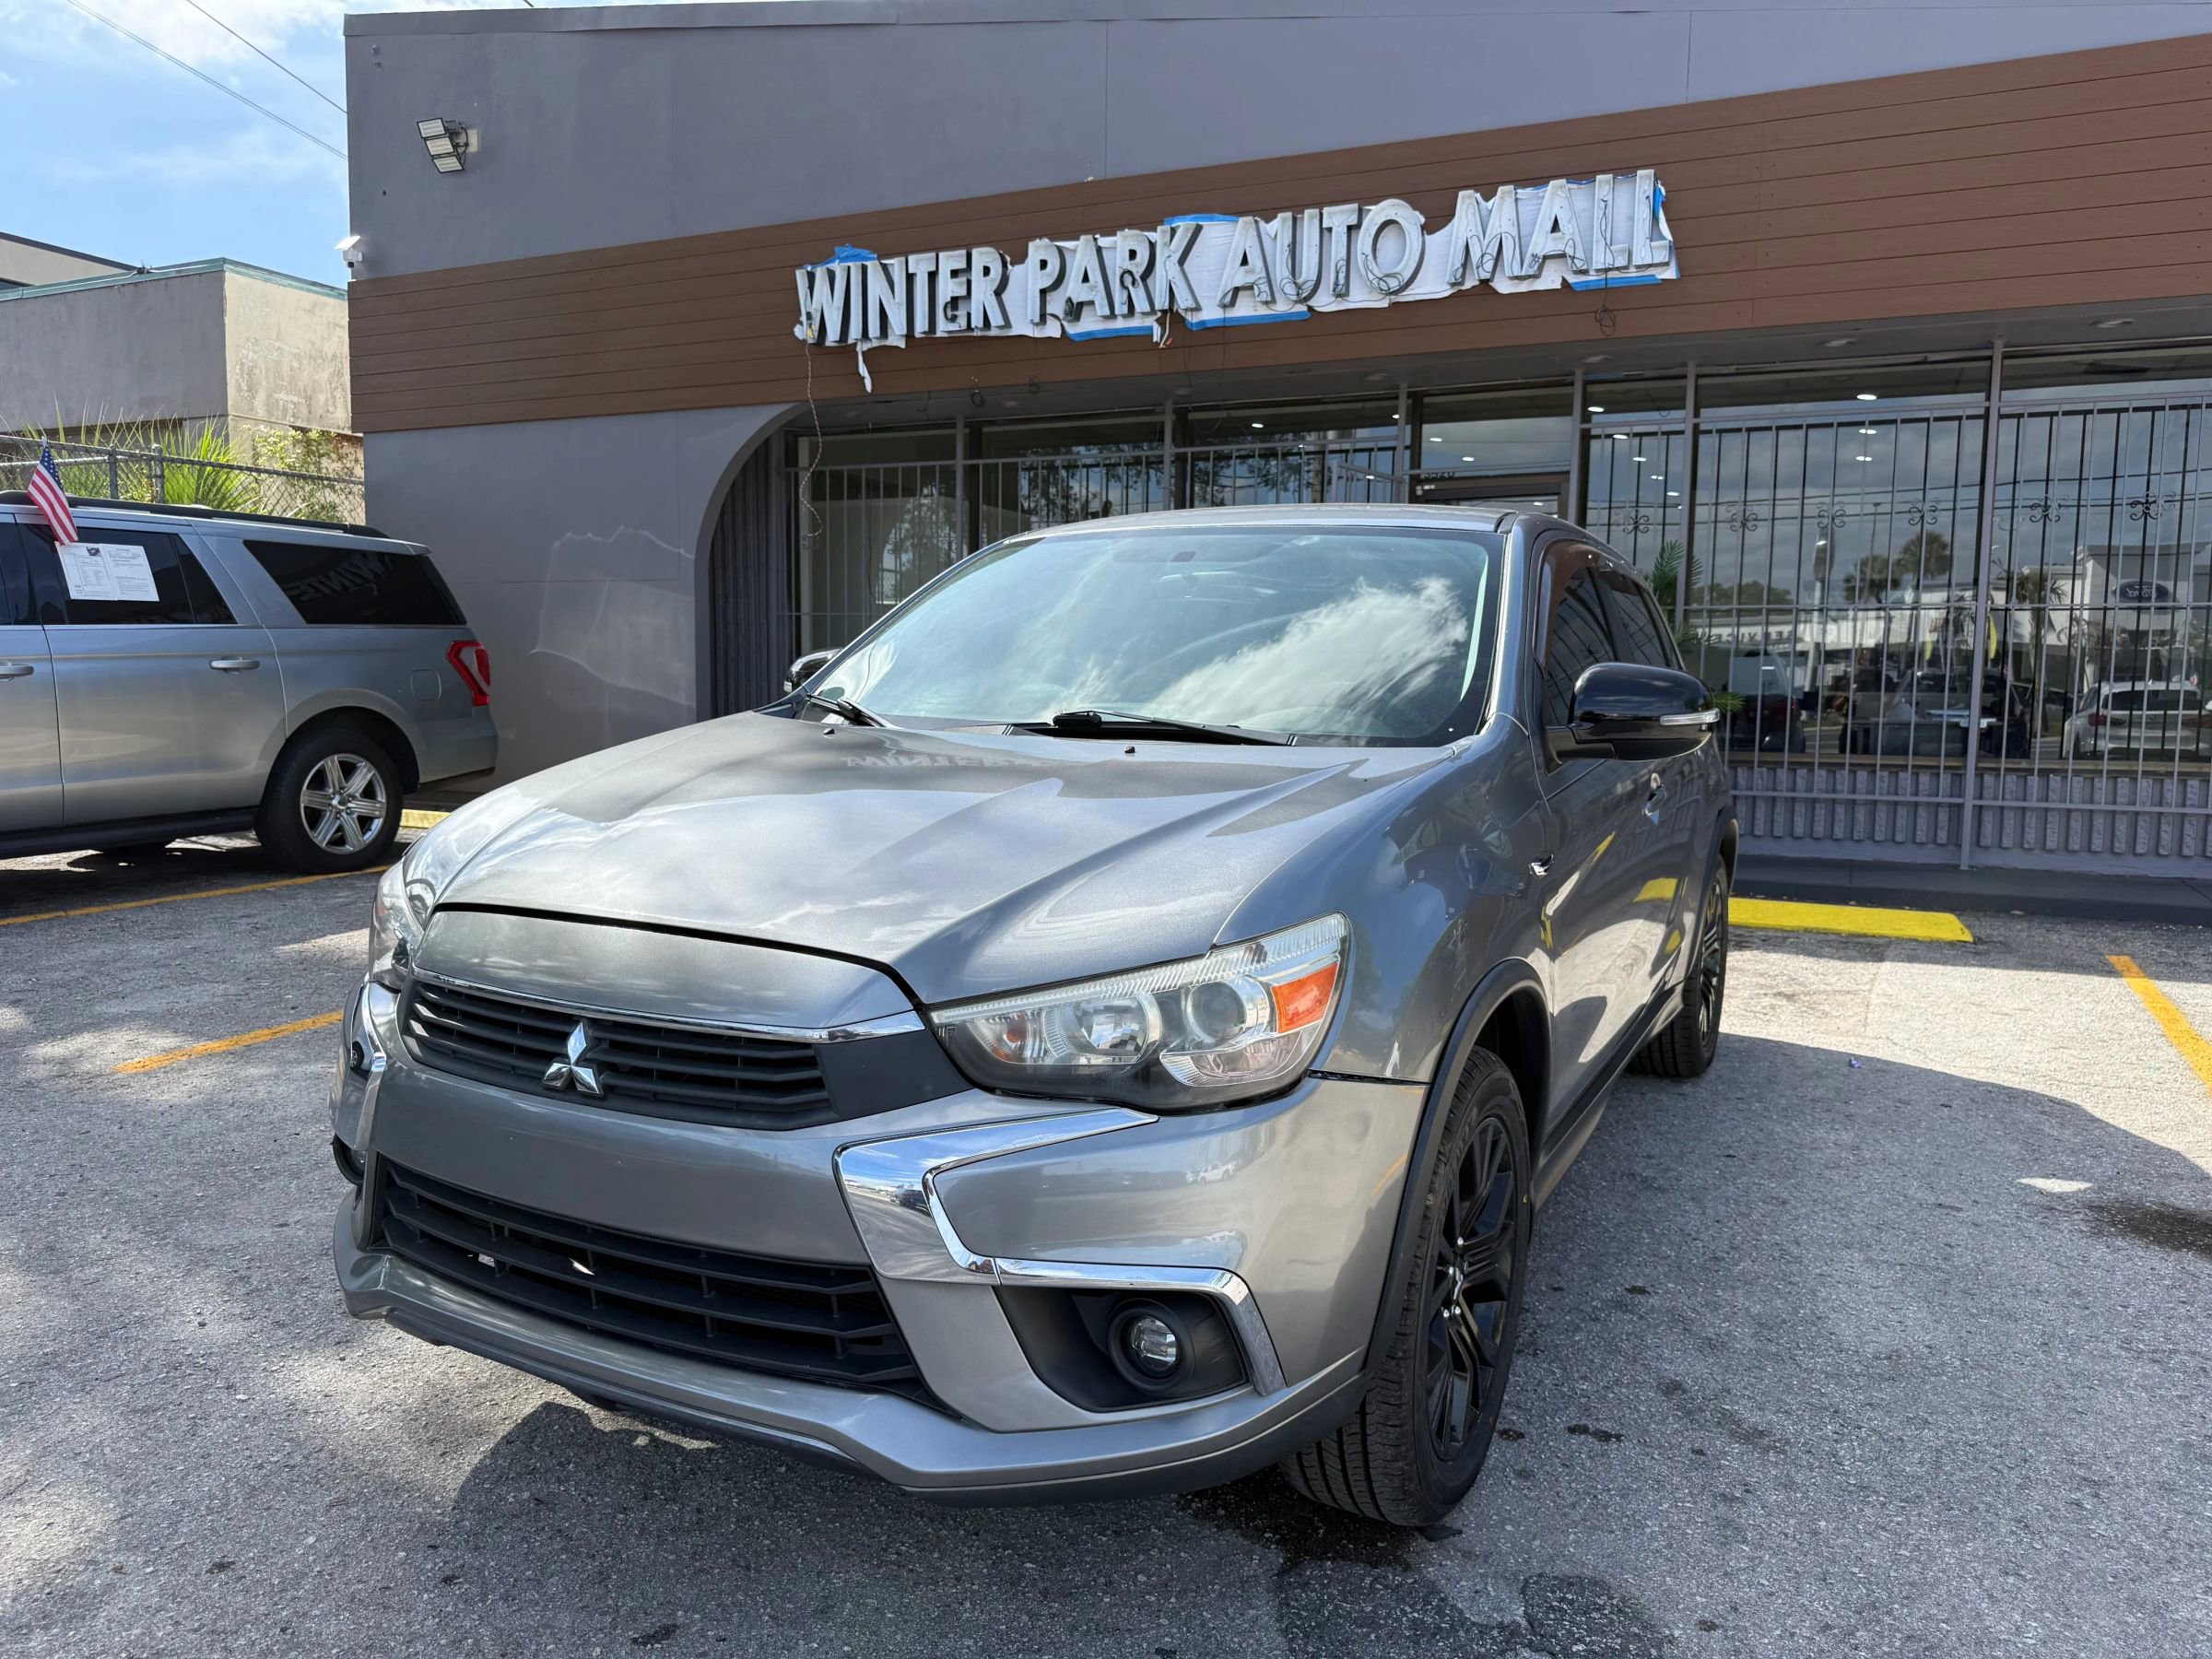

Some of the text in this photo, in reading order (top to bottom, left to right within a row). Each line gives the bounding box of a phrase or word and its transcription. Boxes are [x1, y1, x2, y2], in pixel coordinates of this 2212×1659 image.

[795, 169, 1670, 345] WINTER PARK AUTO MALL
